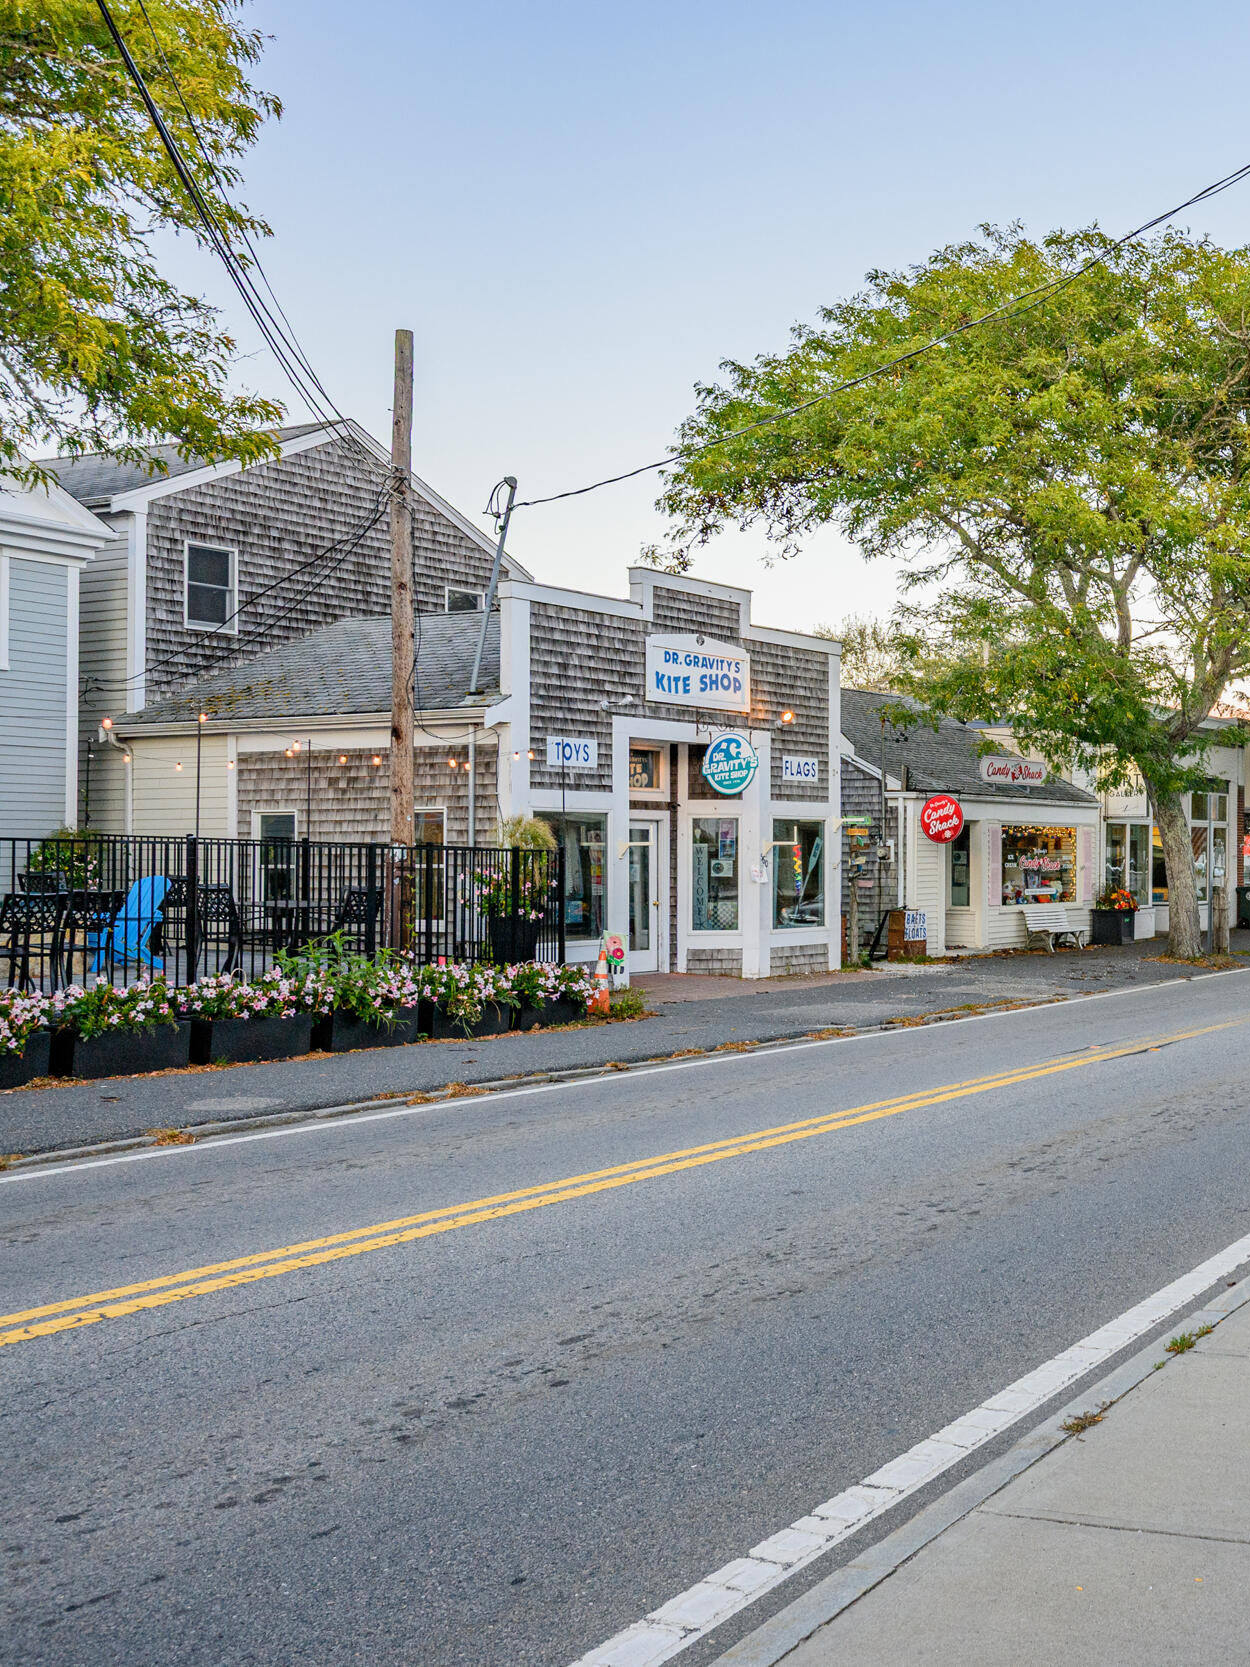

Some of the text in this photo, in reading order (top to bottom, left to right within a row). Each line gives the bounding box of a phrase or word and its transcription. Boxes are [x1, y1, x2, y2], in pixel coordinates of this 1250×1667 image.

[664, 650, 682, 665] DR.
[655, 670, 742, 694] KITE SHOP
[555, 741, 590, 762] TOYS
[702, 755, 759, 775] GRAVITY'S
[714, 769, 749, 781] KITE SHOP
[785, 760, 816, 778] FLAGS
[986, 761, 1043, 781] Candy Shack
[924, 802, 955, 823] Candy
[929, 814, 960, 835] Shack
[695, 846, 705, 917] WELCOME
